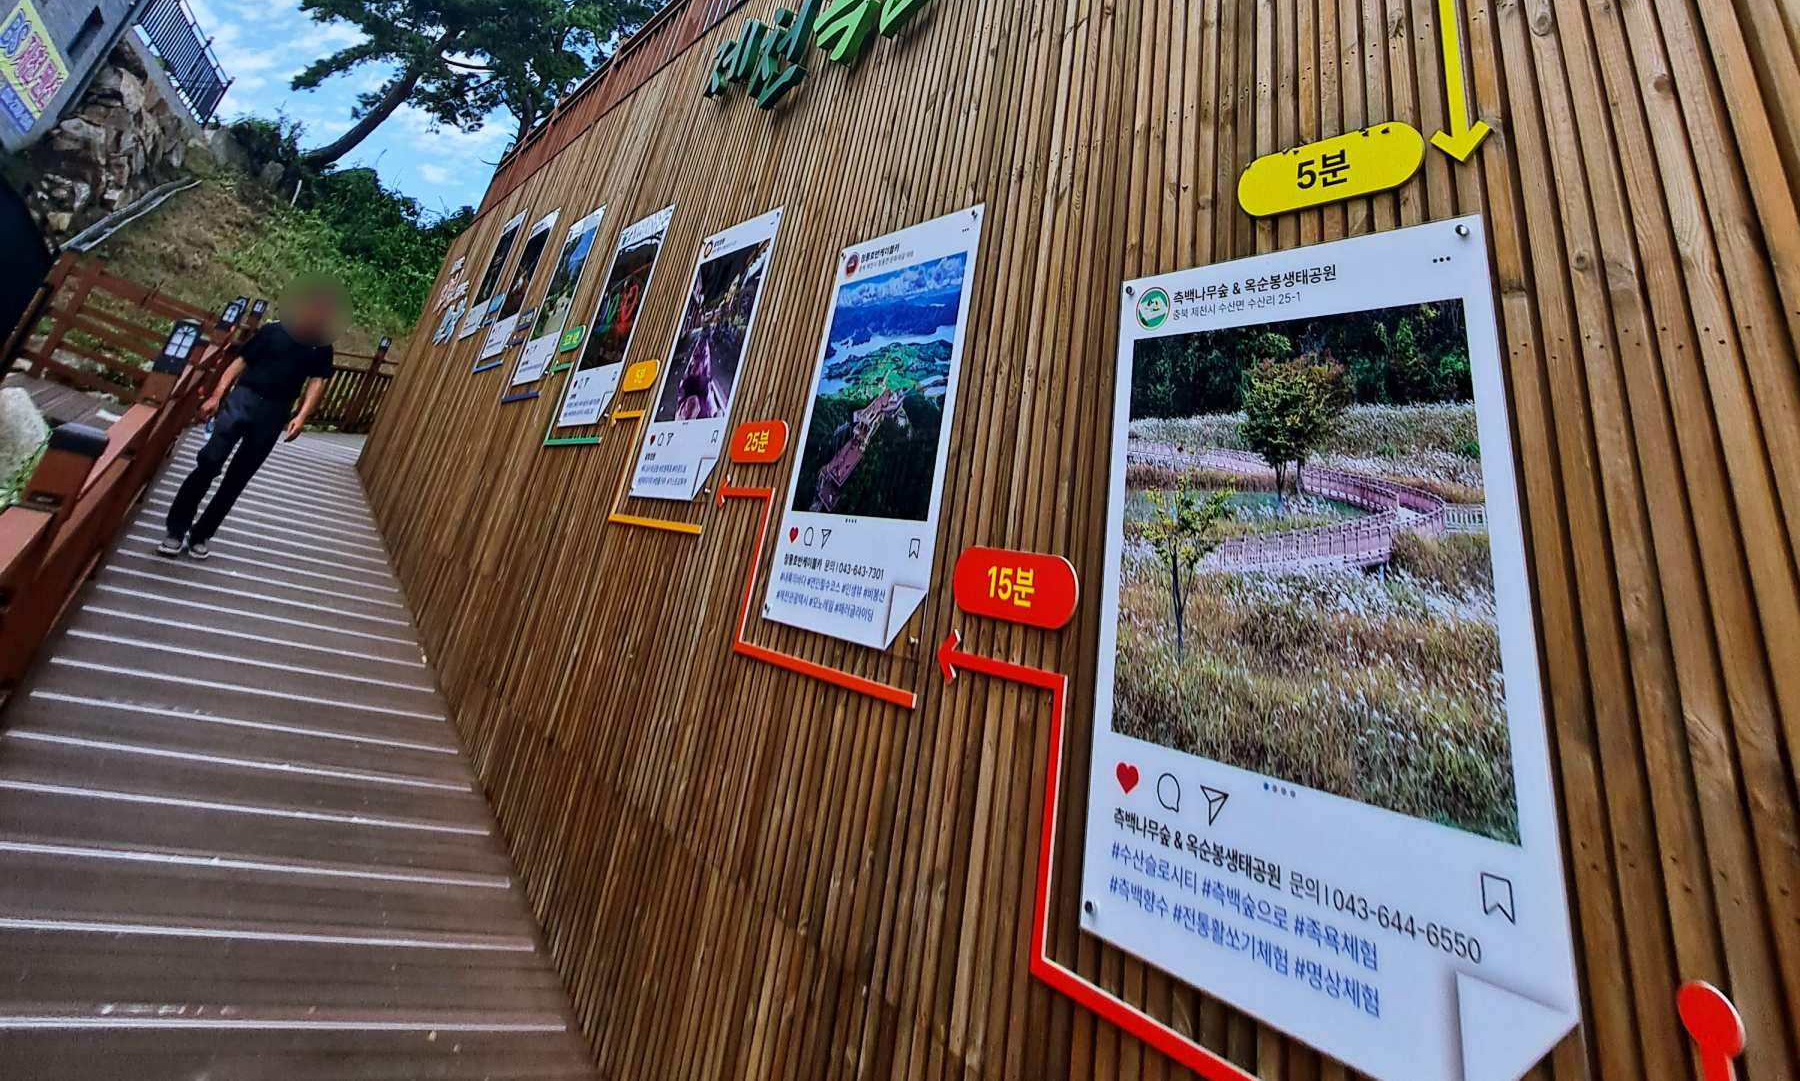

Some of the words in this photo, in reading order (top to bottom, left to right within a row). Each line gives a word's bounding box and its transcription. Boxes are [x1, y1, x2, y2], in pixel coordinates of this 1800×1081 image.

[1297, 148, 1350, 189] 5분
[1232, 282, 1241, 295] &
[1244, 264, 1337, 293] 옥순봉생태공원
[1190, 304, 1216, 317] 제천시
[1218, 300, 1245, 313] 수산면
[1248, 295, 1276, 309] 수산리
[1278, 291, 1301, 305] 25-1
[743, 430, 769, 454] 25분
[987, 565, 1035, 608] 15분
[1174, 830, 1183, 850] &
[1186, 833, 1281, 890] 옥순봉생태공원
[1111, 841, 1197, 895] #수산슬로시티
[1293, 915, 1379, 971] #족욕체험
[1172, 903, 1289, 977] #전통활쏘기체험
[1293, 957, 1380, 1018] #명상체험
